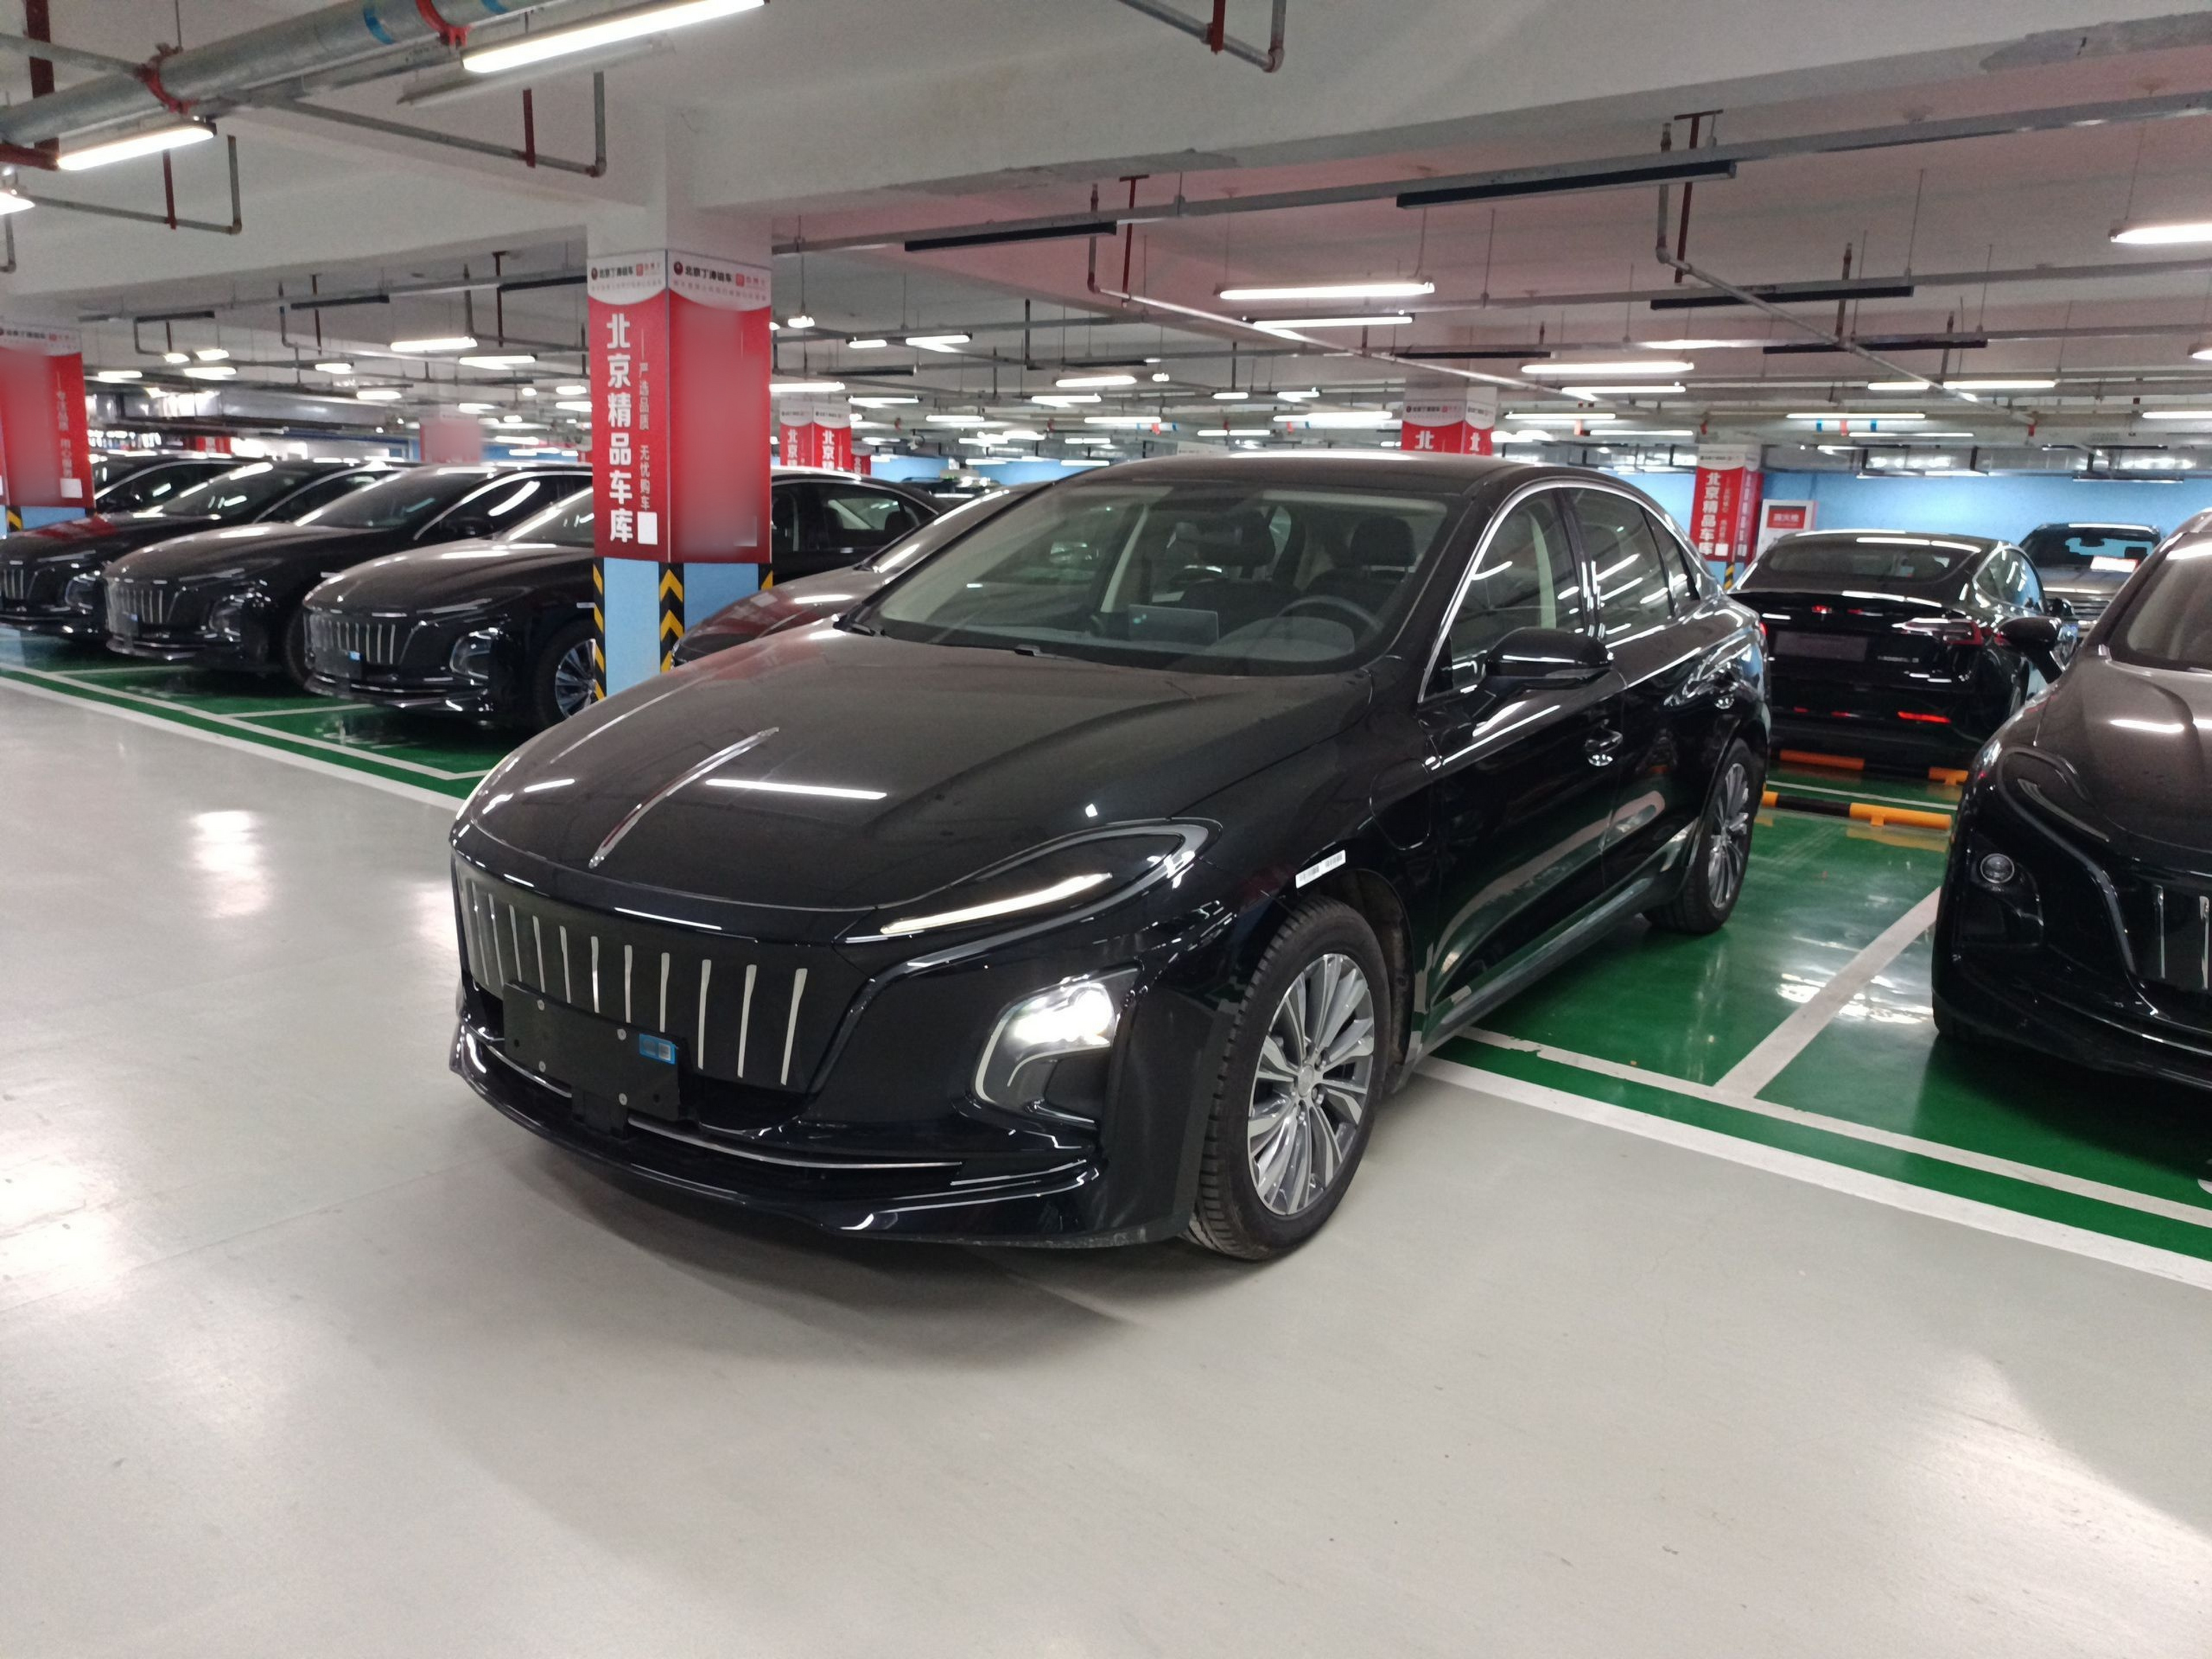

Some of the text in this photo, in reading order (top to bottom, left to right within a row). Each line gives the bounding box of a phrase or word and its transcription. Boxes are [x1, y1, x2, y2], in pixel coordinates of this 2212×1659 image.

[607, 313, 632, 543] 北京精品车库
[639, 362, 650, 511] 严选品质 无忧购车
[1415, 430, 1434, 449] 北
[1699, 472, 1721, 555] 北京精品车库
